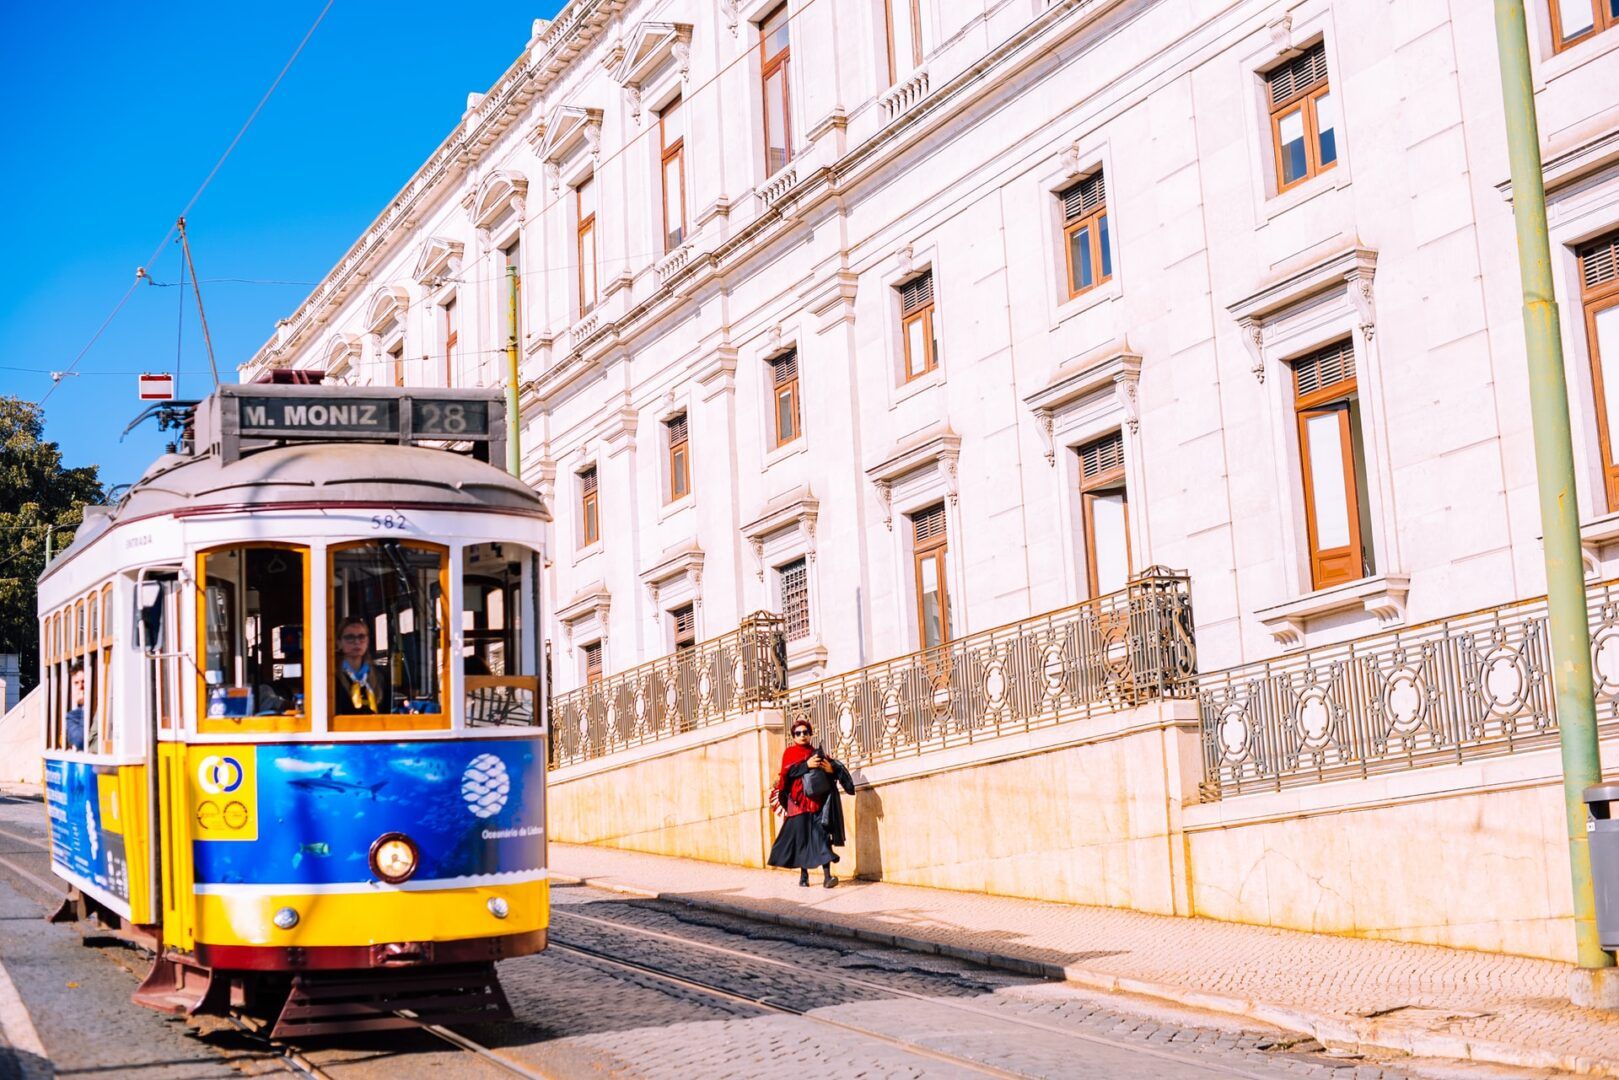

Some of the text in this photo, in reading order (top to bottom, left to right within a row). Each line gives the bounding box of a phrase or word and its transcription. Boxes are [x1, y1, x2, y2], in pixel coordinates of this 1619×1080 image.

[244, 405, 378, 426] M. MONIZ
[421, 403, 467, 433] 28
[371, 514, 406, 530] 582
